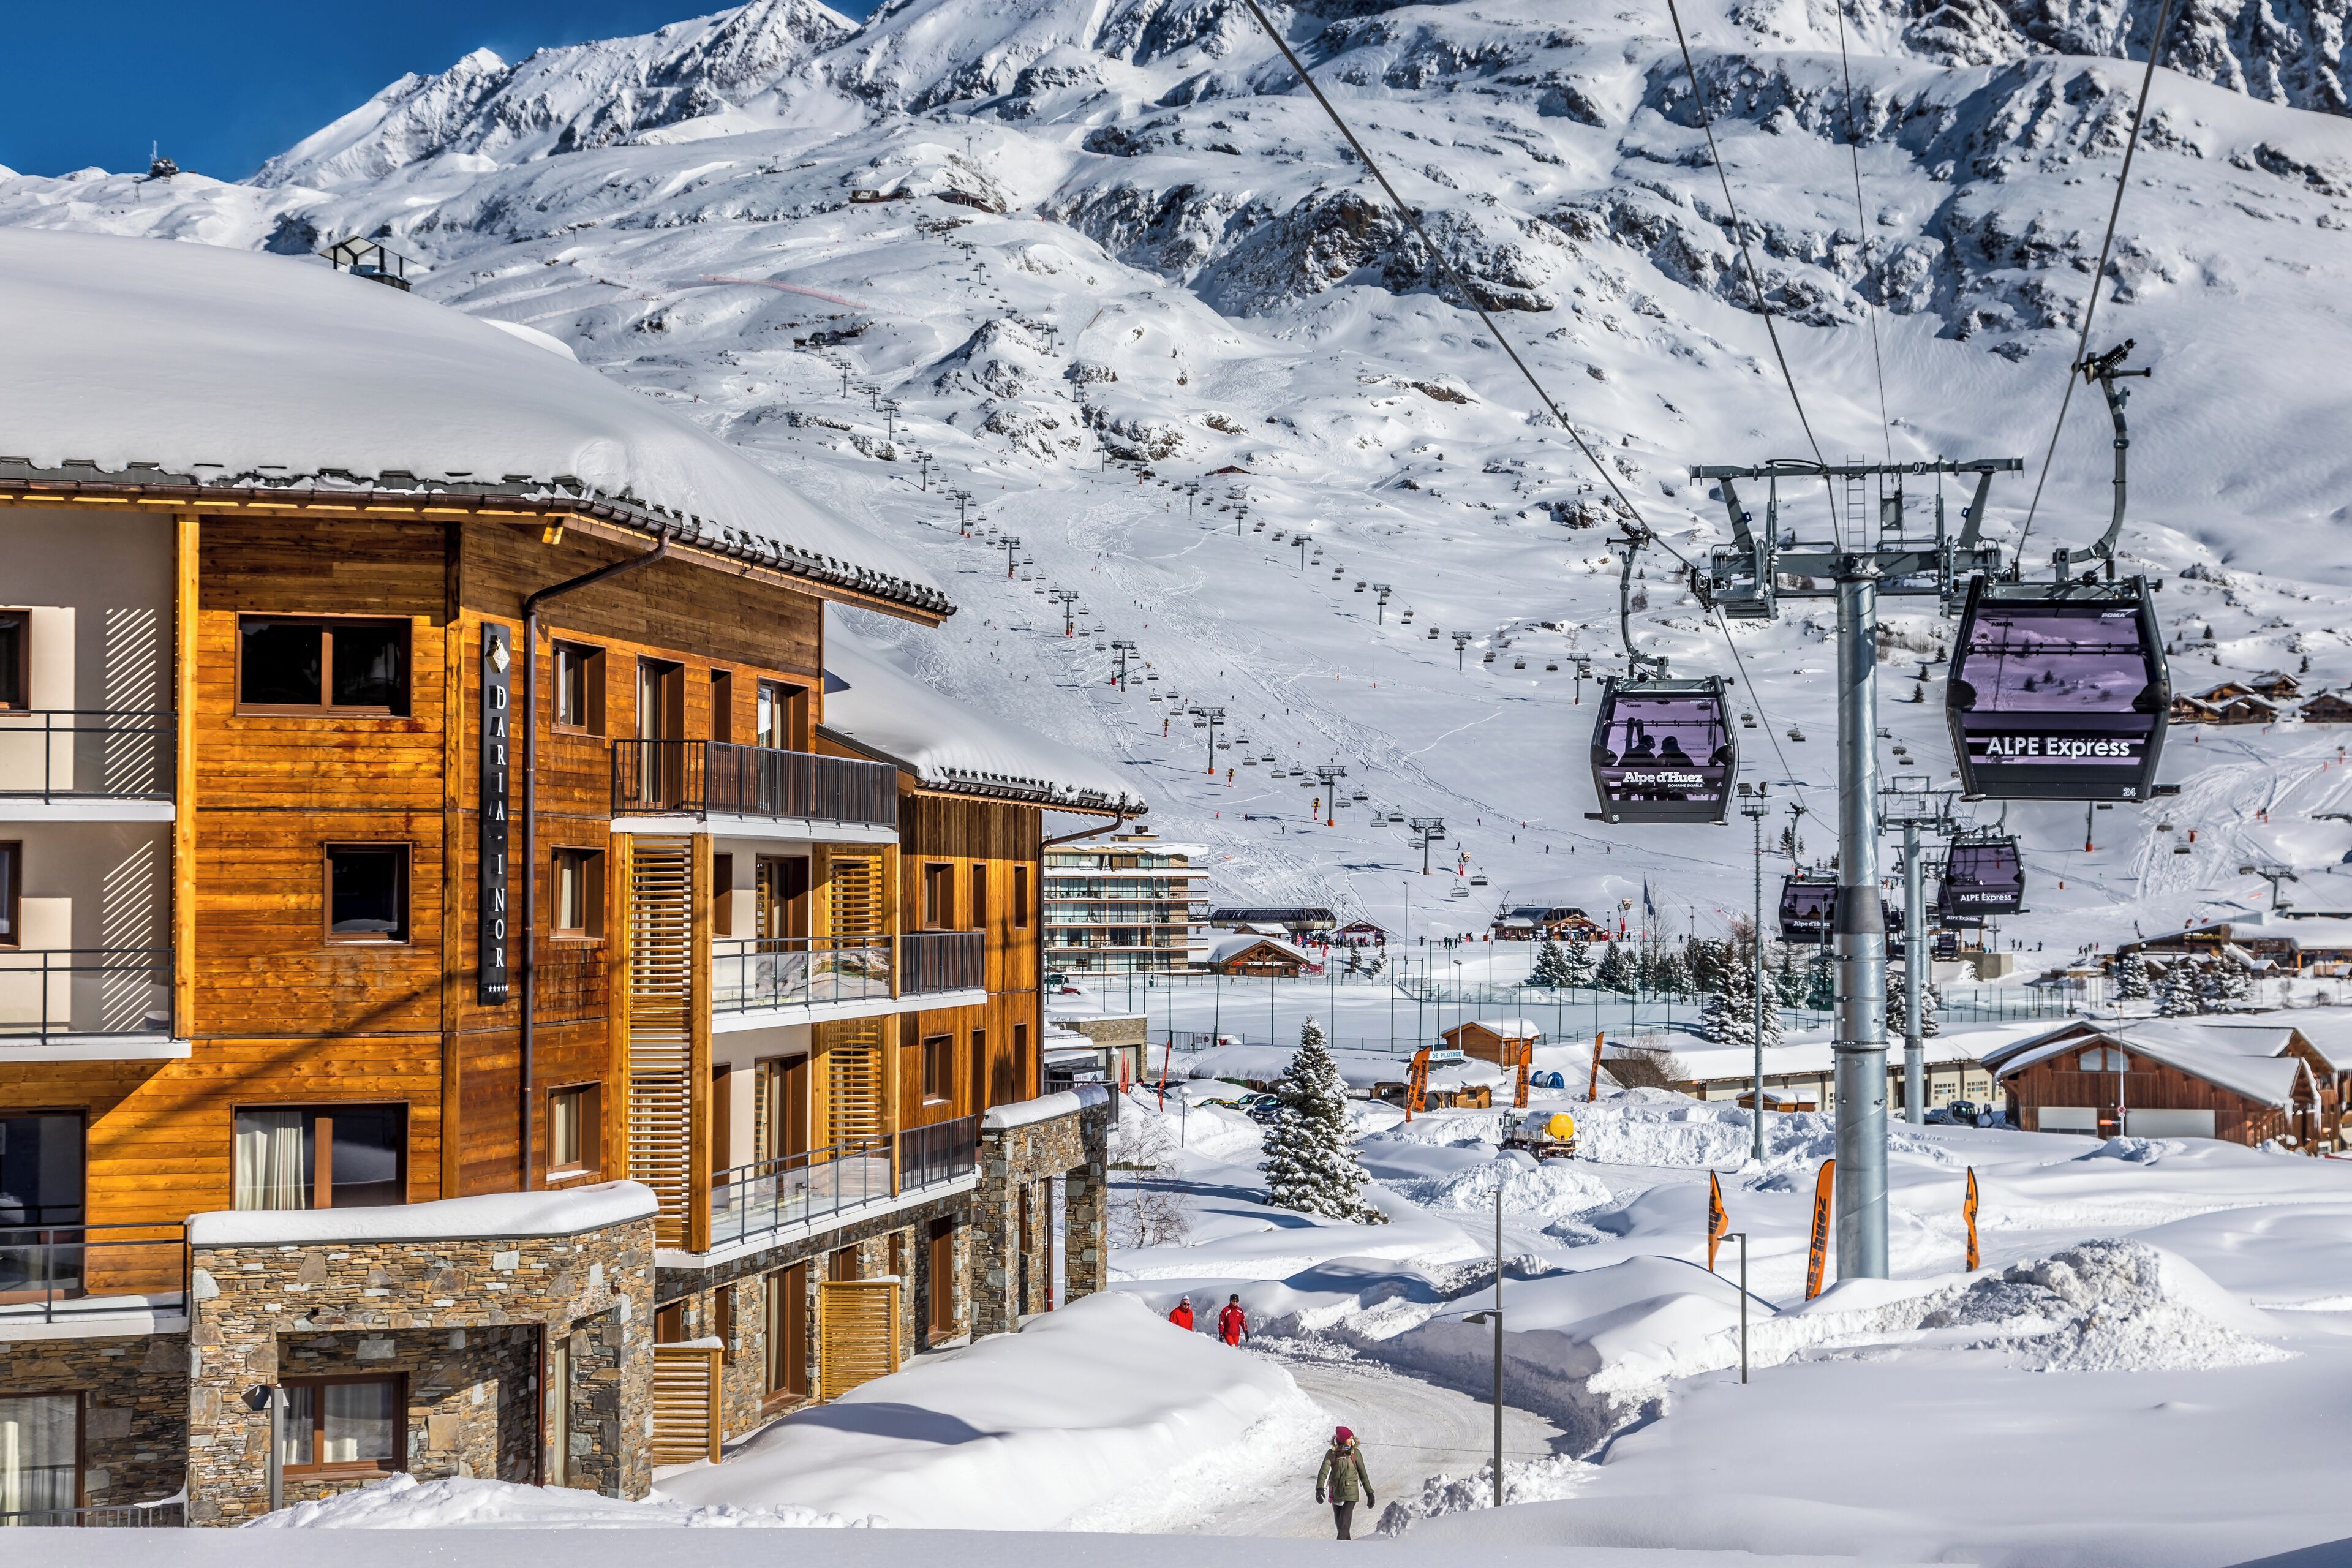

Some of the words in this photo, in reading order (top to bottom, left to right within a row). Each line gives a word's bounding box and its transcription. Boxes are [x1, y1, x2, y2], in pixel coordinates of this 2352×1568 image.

[1913, 462, 1926, 472] 07
[1986, 737, 2039, 755] ALPE
[2047, 736, 2130, 760] Express
[1623, 772, 1655, 785] Alpe
[1656, 772, 1703, 783] d'Huez
[2123, 787, 2136, 797] 24
[1981, 894, 2012, 902] Express
[1812, 1196, 1827, 1252] huez
